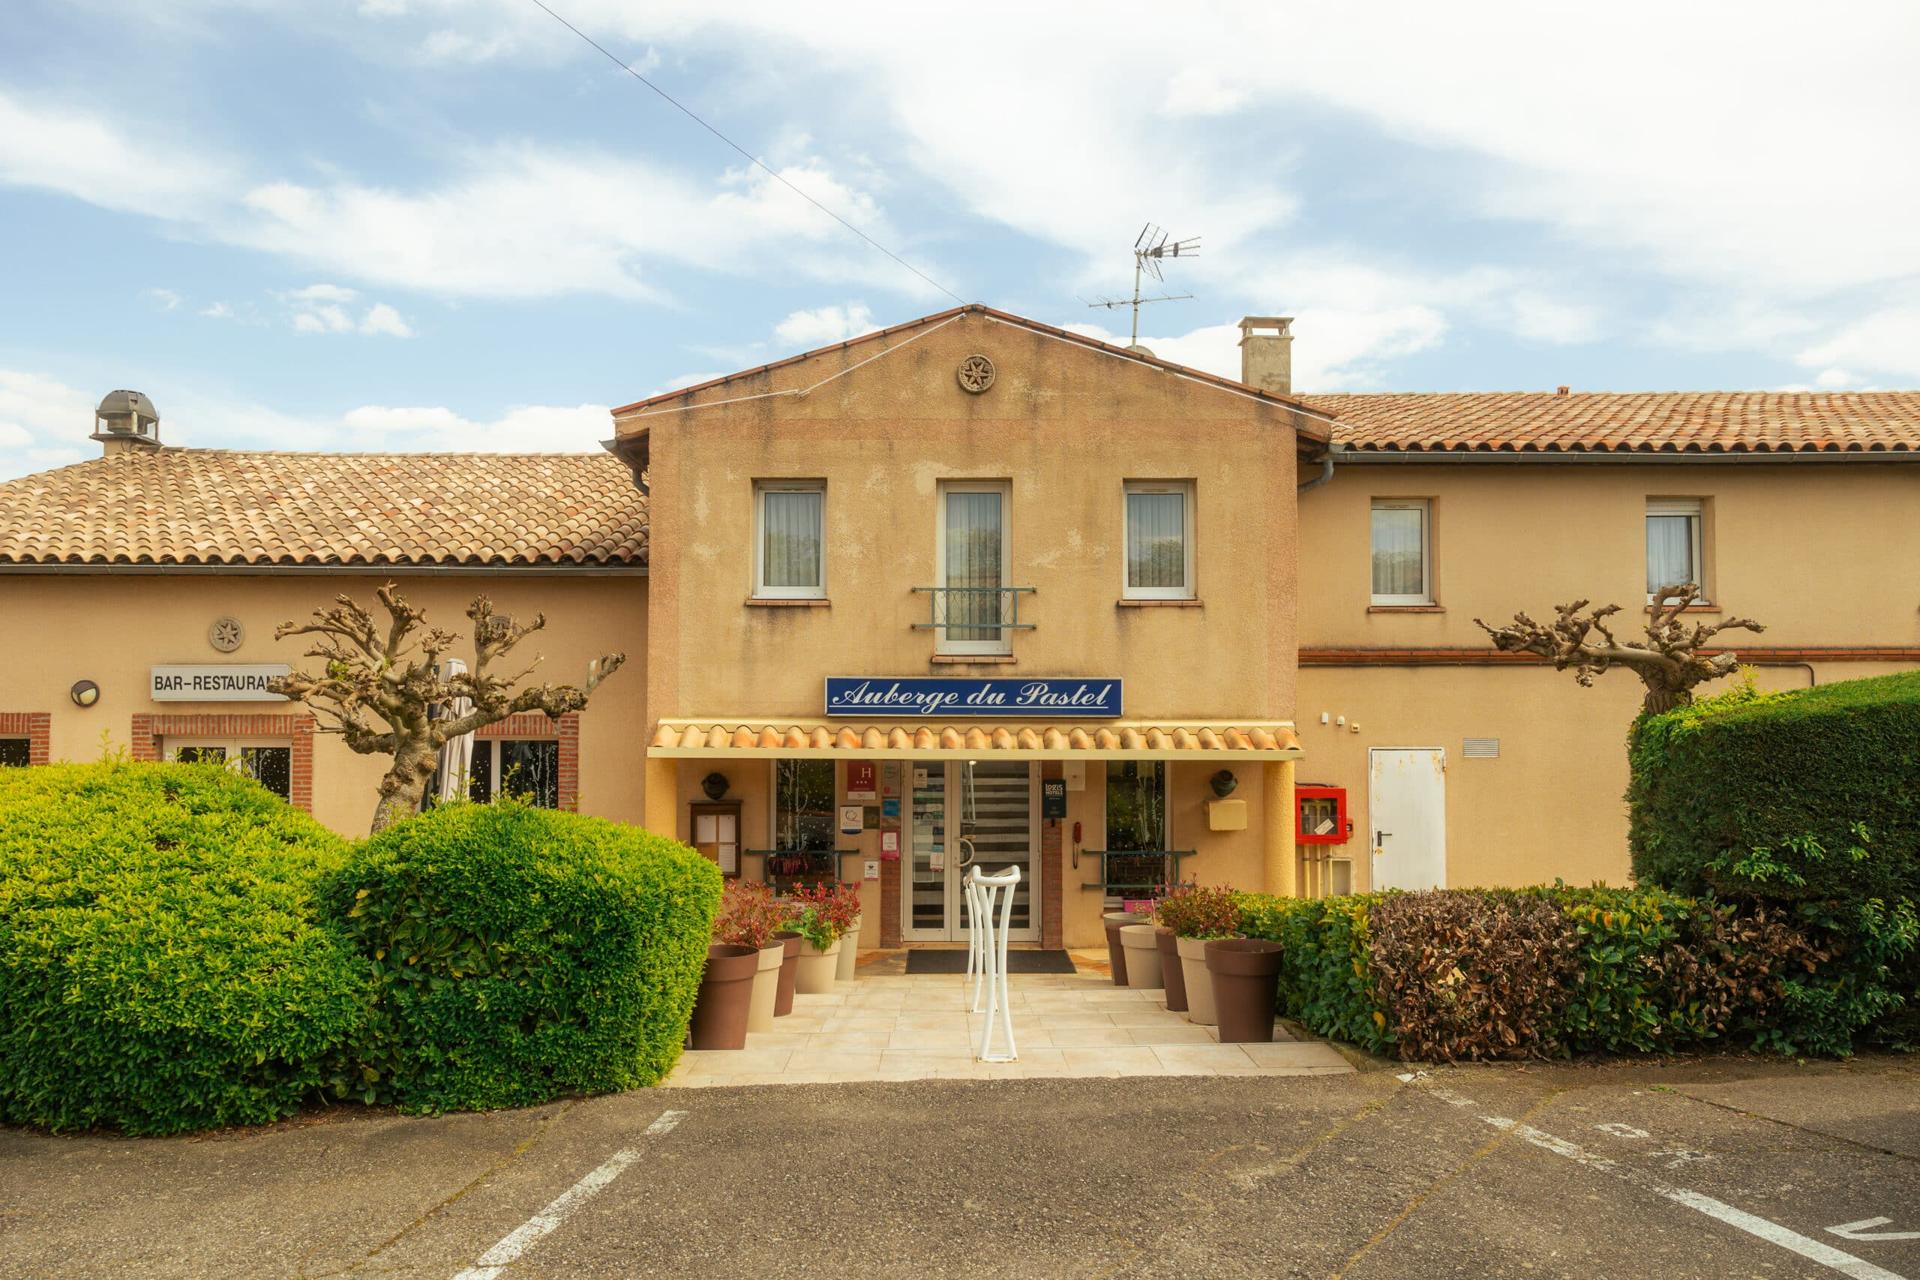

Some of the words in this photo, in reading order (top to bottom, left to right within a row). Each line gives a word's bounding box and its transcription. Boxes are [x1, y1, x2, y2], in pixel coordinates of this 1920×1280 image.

[154, 675, 284, 691] BAR-RESTAURA
[832, 681, 959, 714] Auberge
[966, 683, 1006, 705] du
[1016, 682, 1112, 706] Pastel
[861, 767, 872, 778] H
